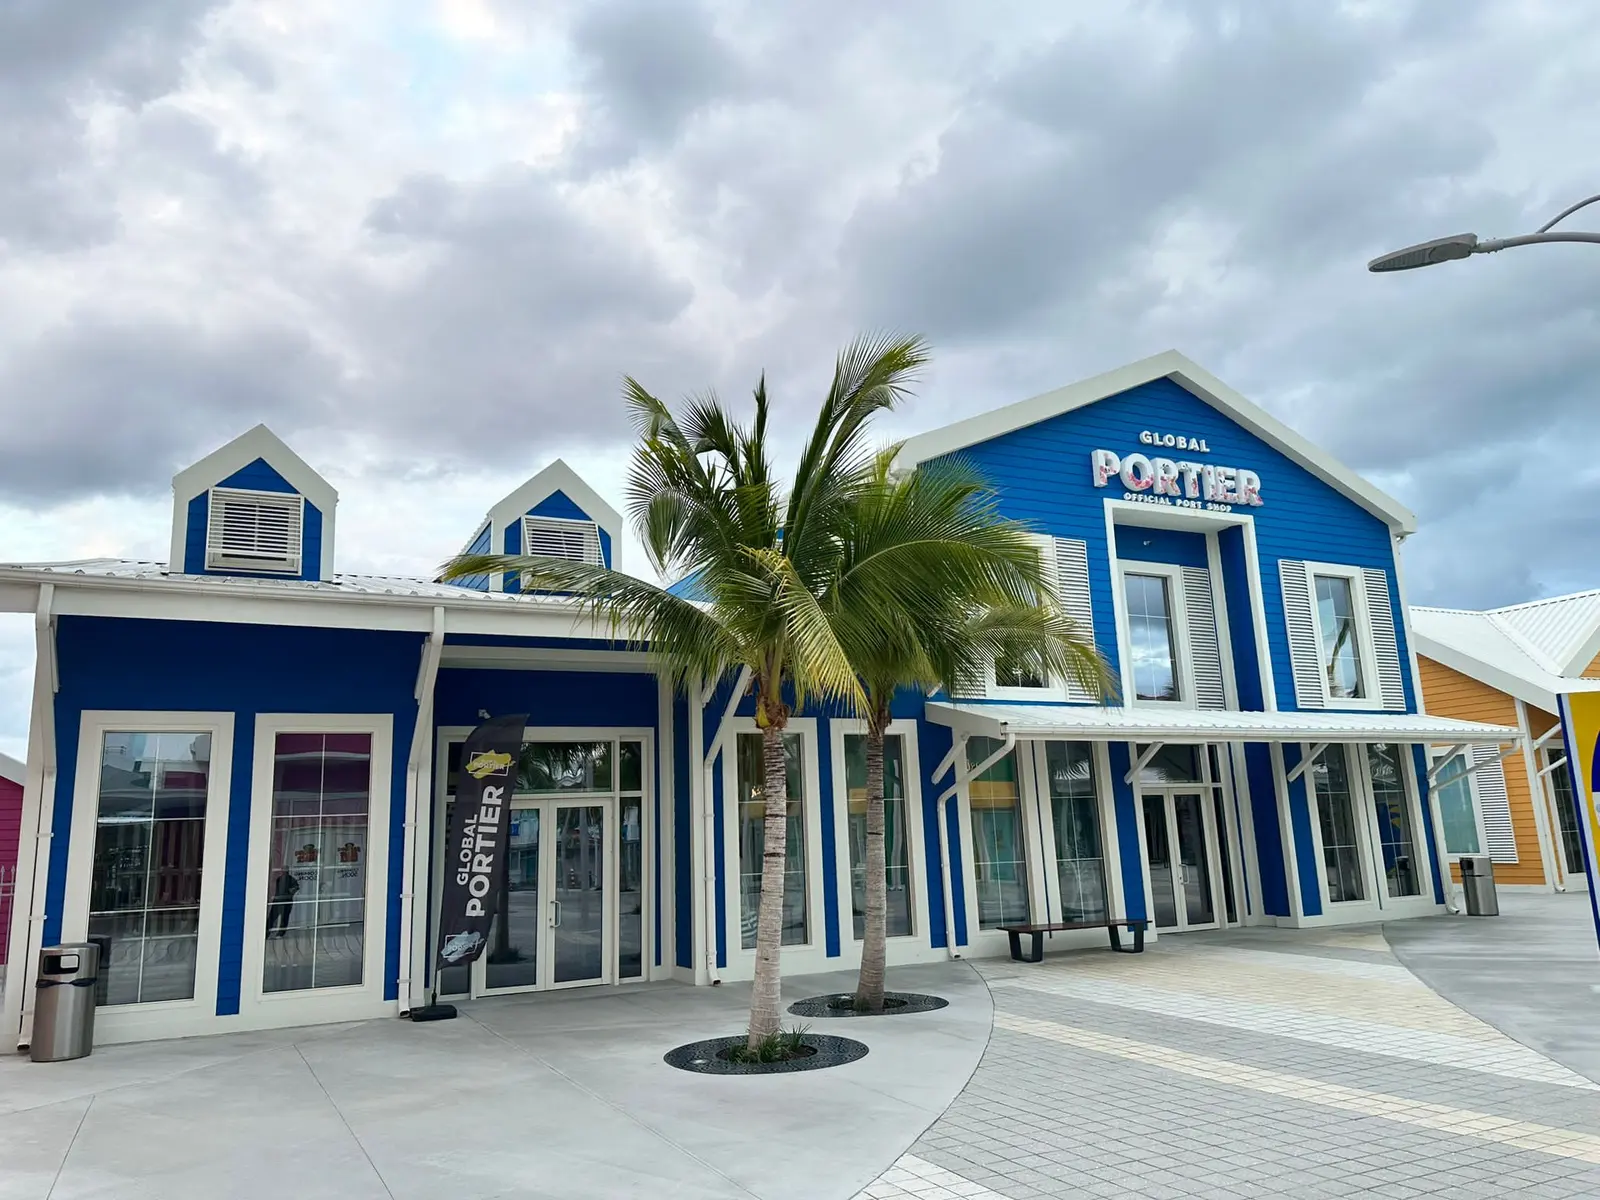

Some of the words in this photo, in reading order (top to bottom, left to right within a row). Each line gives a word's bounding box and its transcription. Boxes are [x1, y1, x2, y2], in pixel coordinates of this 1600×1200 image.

[1139, 430, 1210, 452] GLOBAL
[1091, 449, 1264, 506] PORTIER
[1123, 492, 1172, 505] OFFICIAL
[1176, 499, 1202, 509] PORT
[1206, 503, 1232, 513] SHOP
[457, 814, 478, 886] GLOBAL
[465, 785, 504, 917] PORTIER
